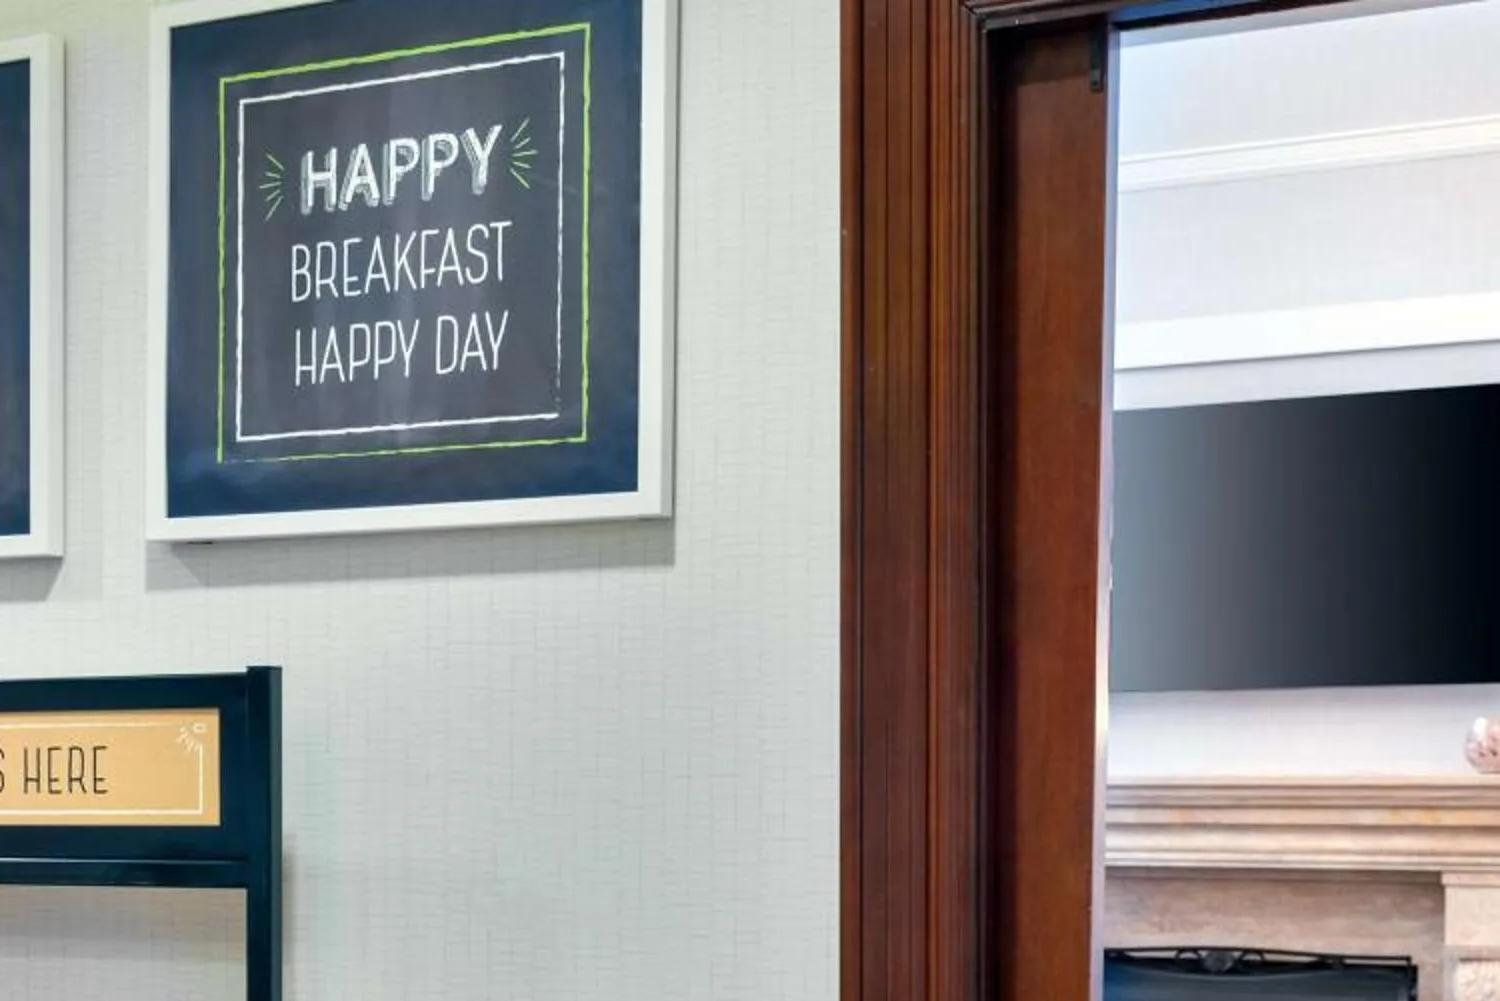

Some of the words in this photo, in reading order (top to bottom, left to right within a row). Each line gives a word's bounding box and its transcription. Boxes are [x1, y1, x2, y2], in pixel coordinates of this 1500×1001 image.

[299, 124, 502, 214] HAPPY
[290, 221, 512, 303] BREAKFAST
[294, 318, 420, 387] HAPPY
[435, 309, 509, 375] DAY
[23, 745, 109, 795] HERE
